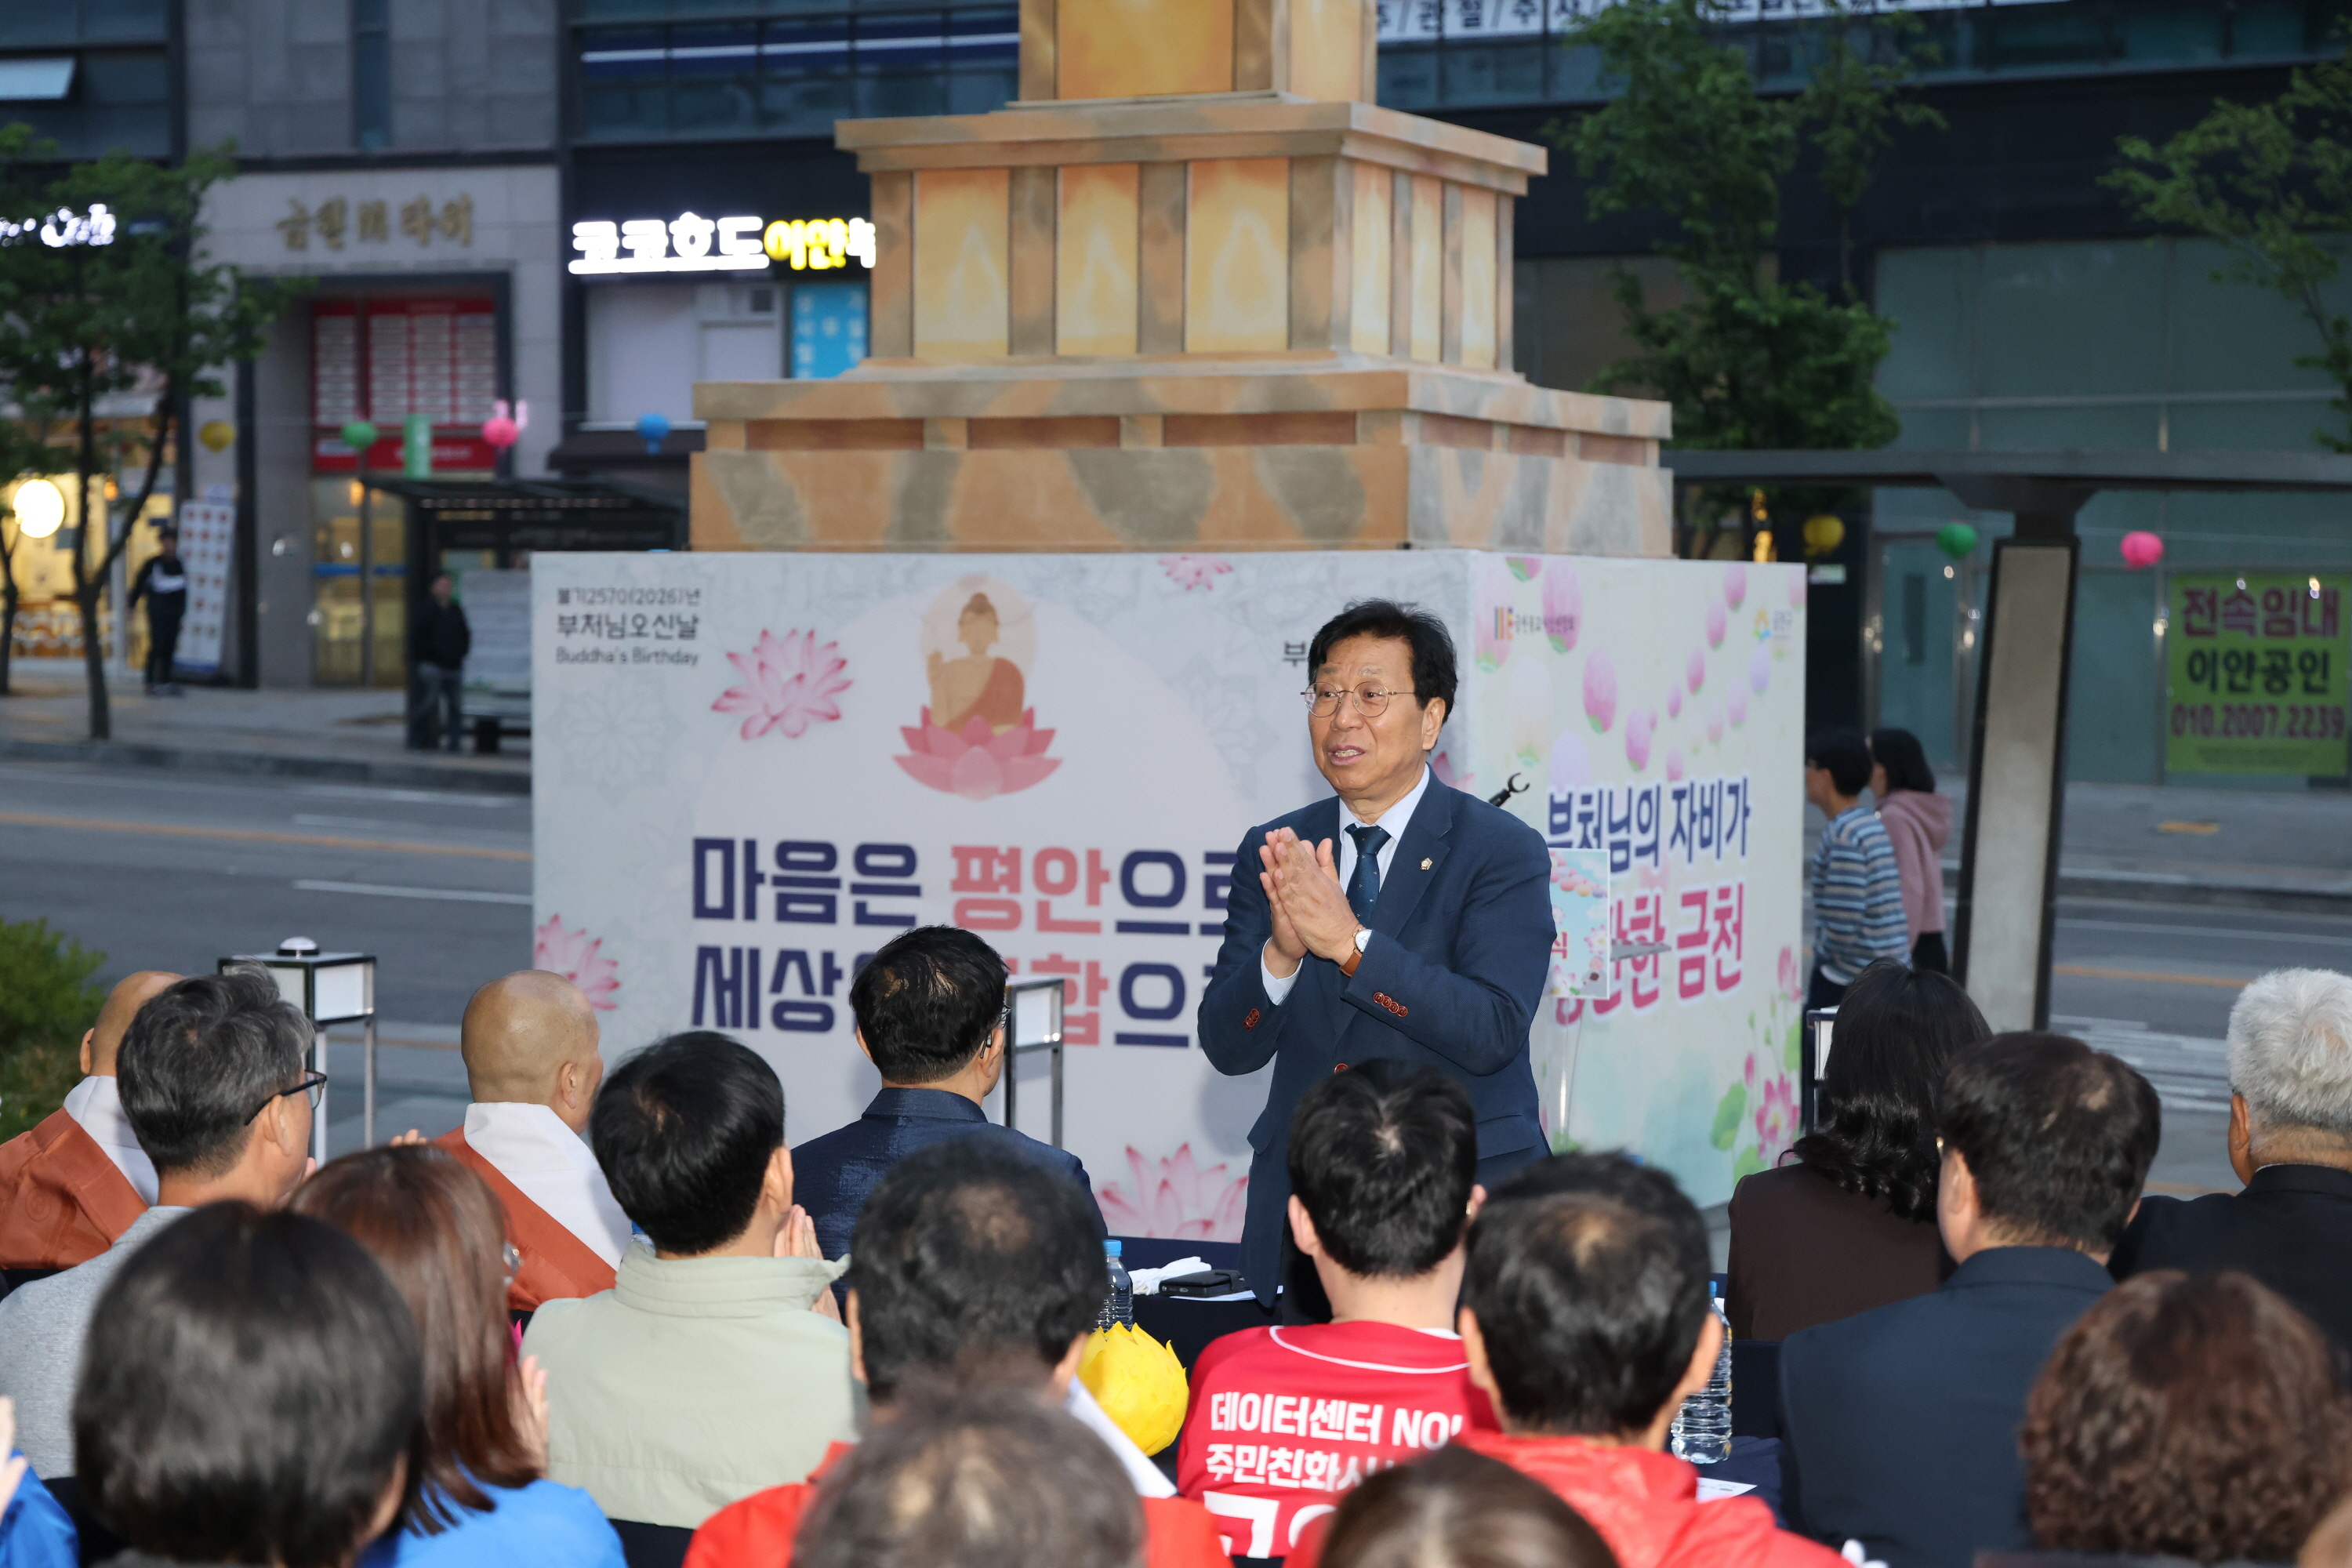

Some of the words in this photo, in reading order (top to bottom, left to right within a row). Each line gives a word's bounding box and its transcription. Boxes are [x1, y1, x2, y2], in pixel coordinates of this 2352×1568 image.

[2182, 588, 2339, 637] 전속임대
[556, 645, 628, 664] Buddha's
[632, 645, 699, 666] Birthday
[2187, 649, 2331, 694] 이안공인
[2171, 703, 2346, 738] 010.2007.2239
[1670, 777, 1751, 864] 자비가
[691, 837, 923, 927] 마음은
[1676, 882, 1744, 999] 금천
[692, 945, 877, 1033] 세상
[1210, 1392, 1383, 1444] 데이터센터
[1206, 1443, 1395, 1492] 주민친화시
